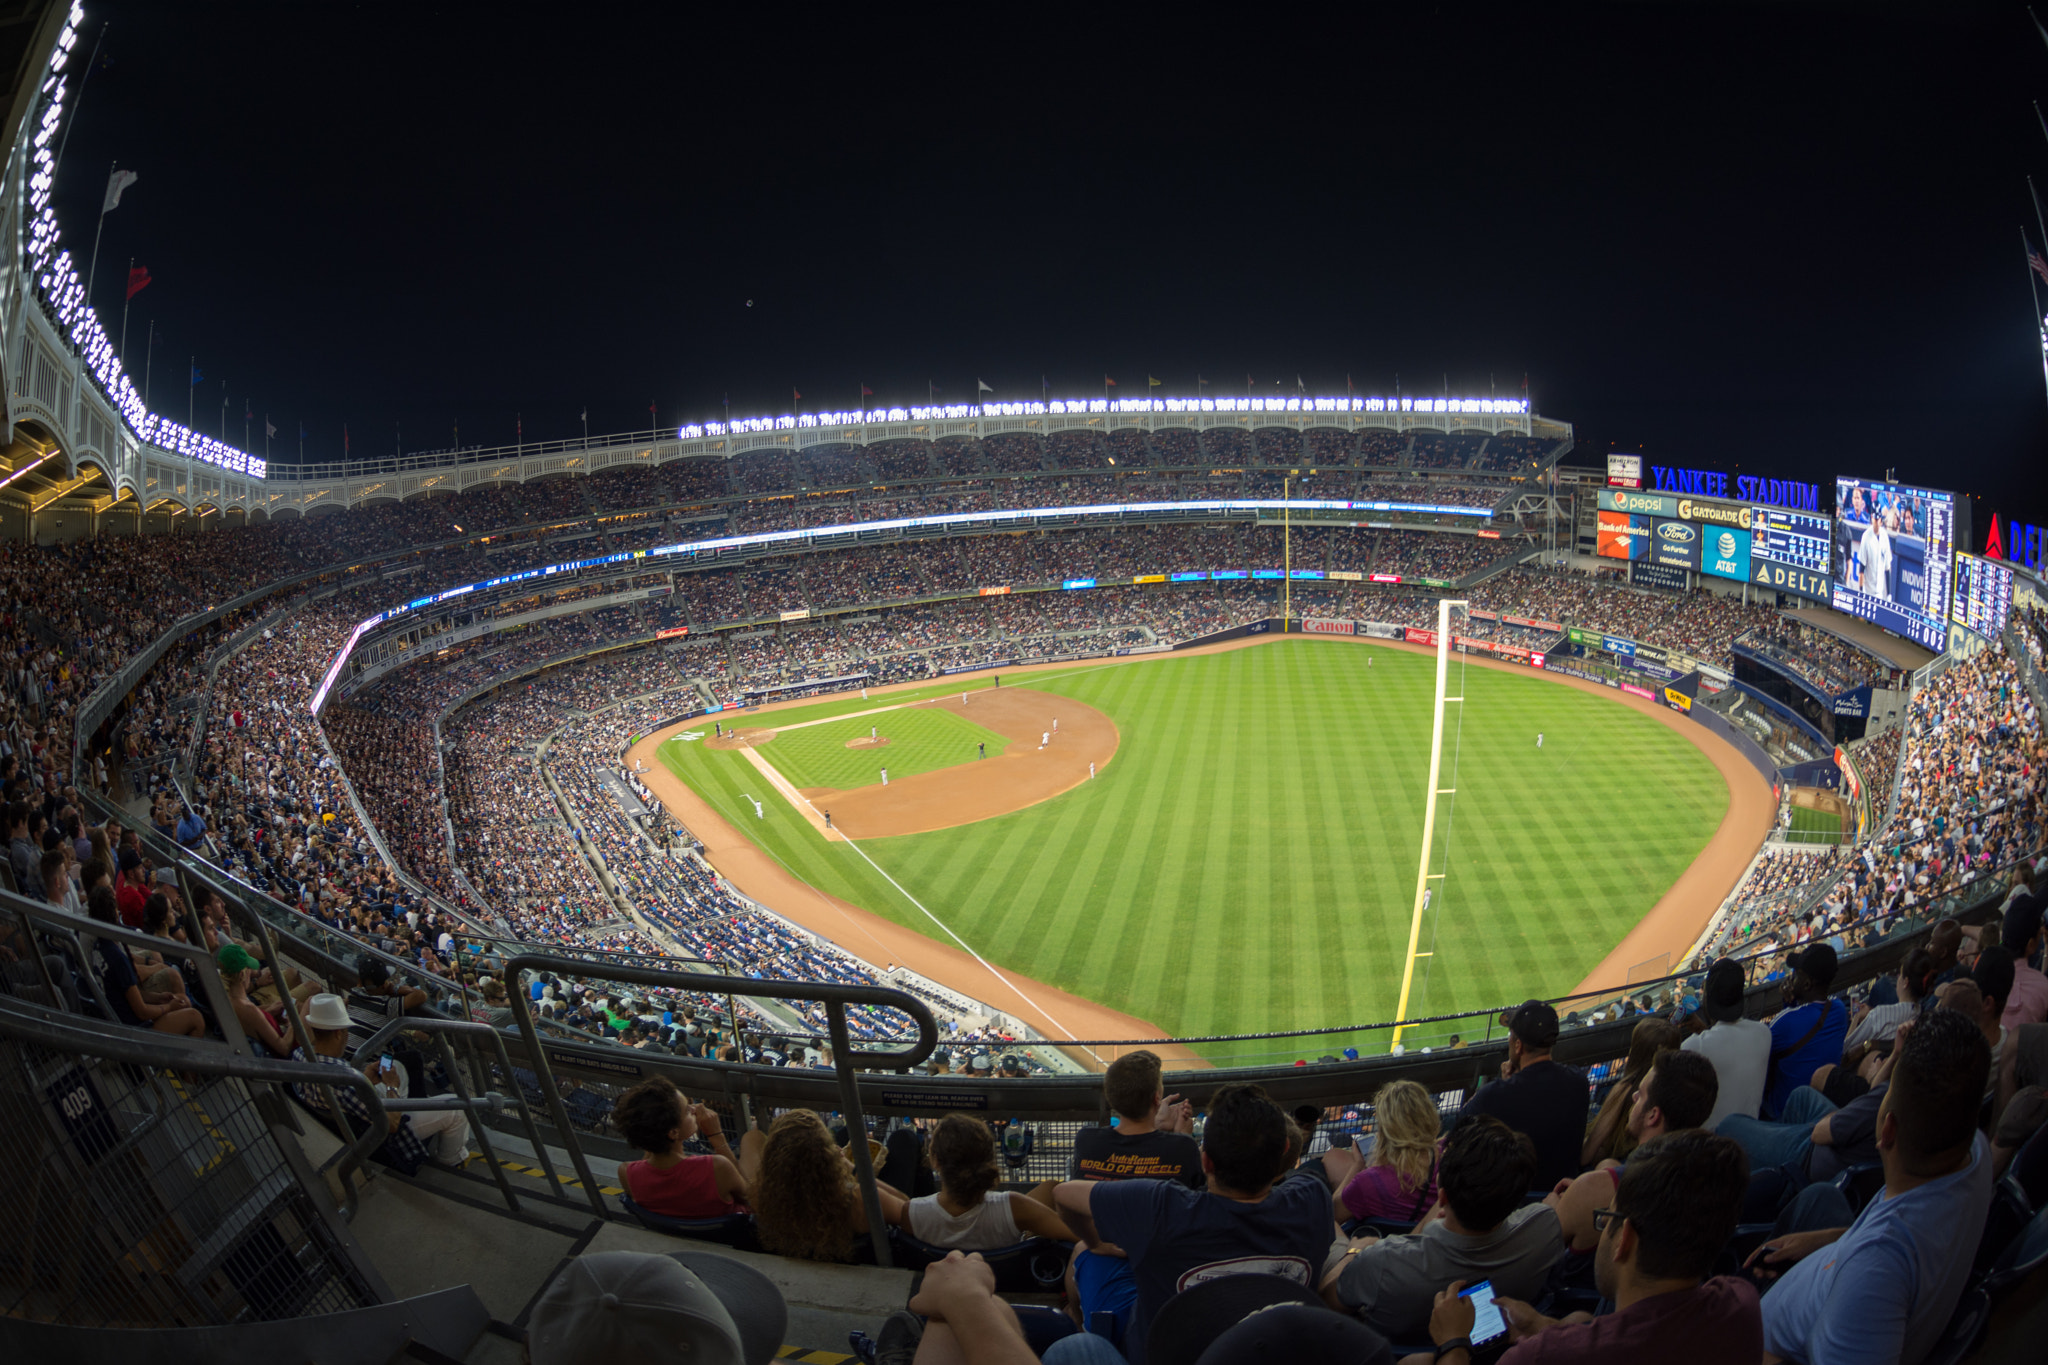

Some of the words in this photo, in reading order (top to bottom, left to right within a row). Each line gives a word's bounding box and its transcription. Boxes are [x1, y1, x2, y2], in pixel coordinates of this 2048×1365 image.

[1651, 465, 1728, 499] YANKEE
[1737, 475, 1819, 512] STADIUM
[1629, 497, 1662, 512] pepsi
[1678, 500, 1692, 519] G
[1692, 506, 1738, 523] GATORADE
[1739, 508, 1751, 529] G
[1599, 522, 1615, 532] Bank
[1615, 524, 1622, 533] of
[1622, 526, 1649, 537] America
[1664, 526, 1688, 540] Ford
[1663, 544, 1671, 552] Go
[1671, 546, 1689, 555] Further
[2010, 520, 2048, 572] DEL
[1715, 559, 1737, 574] AT&T
[1775, 568, 1828, 598] DELTA
[985, 587, 1005, 595] AVIS
[656, 627, 688, 639] Budweiser
[1303, 619, 1353, 633] Canon
[1923, 627, 1929, 643] 0
[1930, 630, 1936, 646] 0
[1937, 635, 1943, 650] 2
[1834, 707, 1852, 715] SPORTS
[1852, 708, 1862, 716] BAR
[620, 1065, 638, 1073] BALLS
[61, 1086, 92, 1119] 409
[1080, 1159, 1115, 1172] WORLD
[1116, 1164, 1133, 1173] OF
[1134, 1165, 1182, 1174] WHEELS
